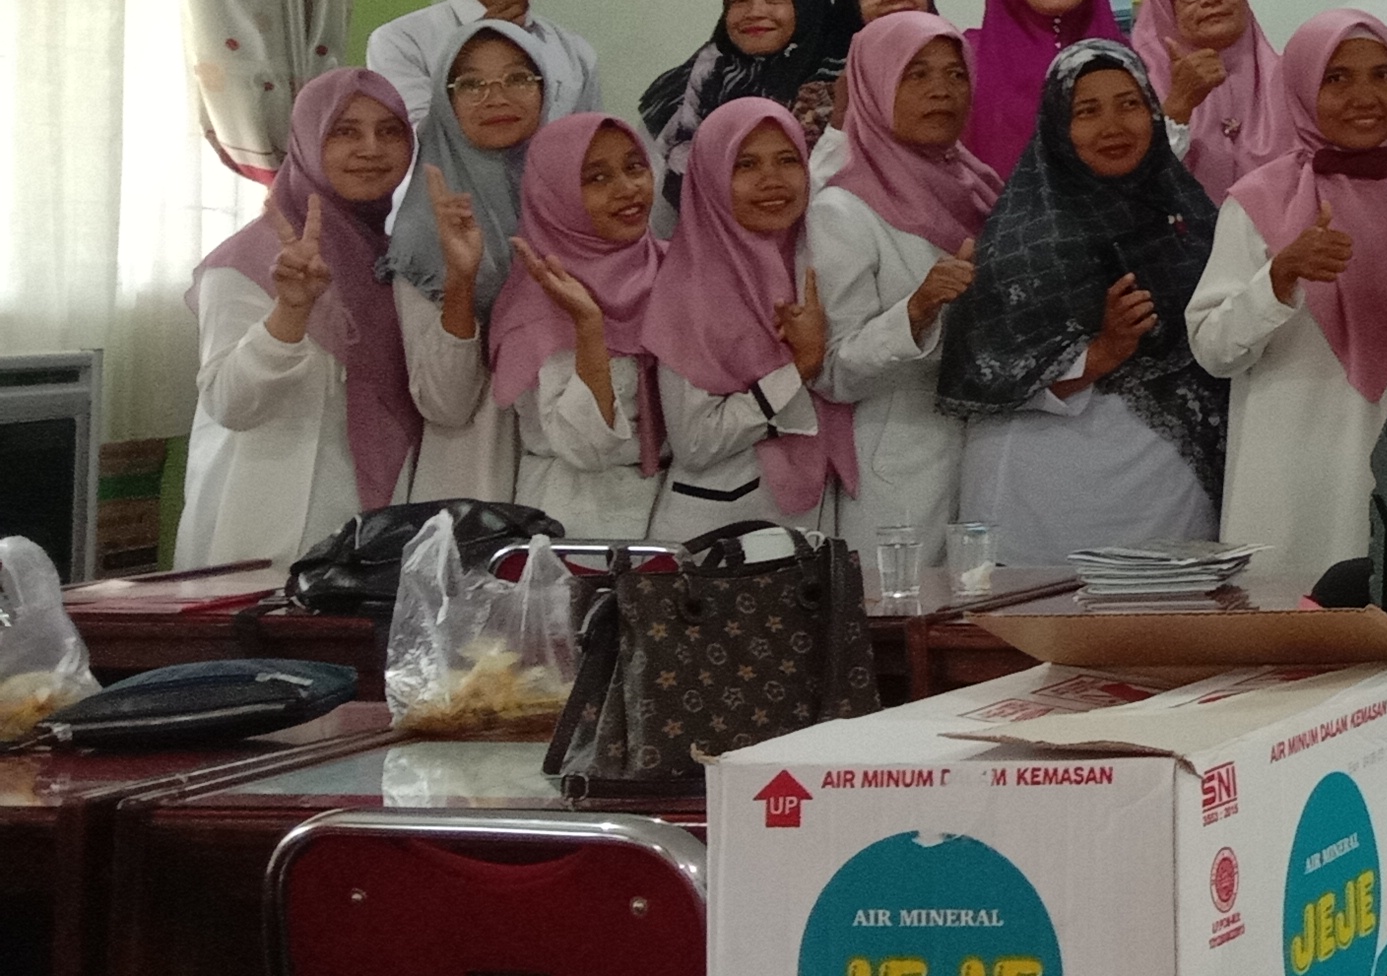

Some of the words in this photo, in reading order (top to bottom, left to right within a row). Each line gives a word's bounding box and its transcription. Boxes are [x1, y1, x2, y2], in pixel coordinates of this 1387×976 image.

[1269, 740, 1286, 764] AIR
[1287, 726, 1319, 757] MINUM
[1320, 714, 1348, 743] DALAM
[821, 769, 856, 789] AIR
[861, 768, 934, 789] MINUM
[1015, 766, 1114, 787] KEMASAN
[1201, 764, 1237, 808] SNI
[769, 796, 798, 816] UP
[1303, 851, 1322, 875] AIR
[1321, 831, 1361, 866] MINERAL
[852, 909, 893, 927] AIR
[899, 908, 1005, 927] MINERAL
[1290, 869, 1376, 976] JEJE
